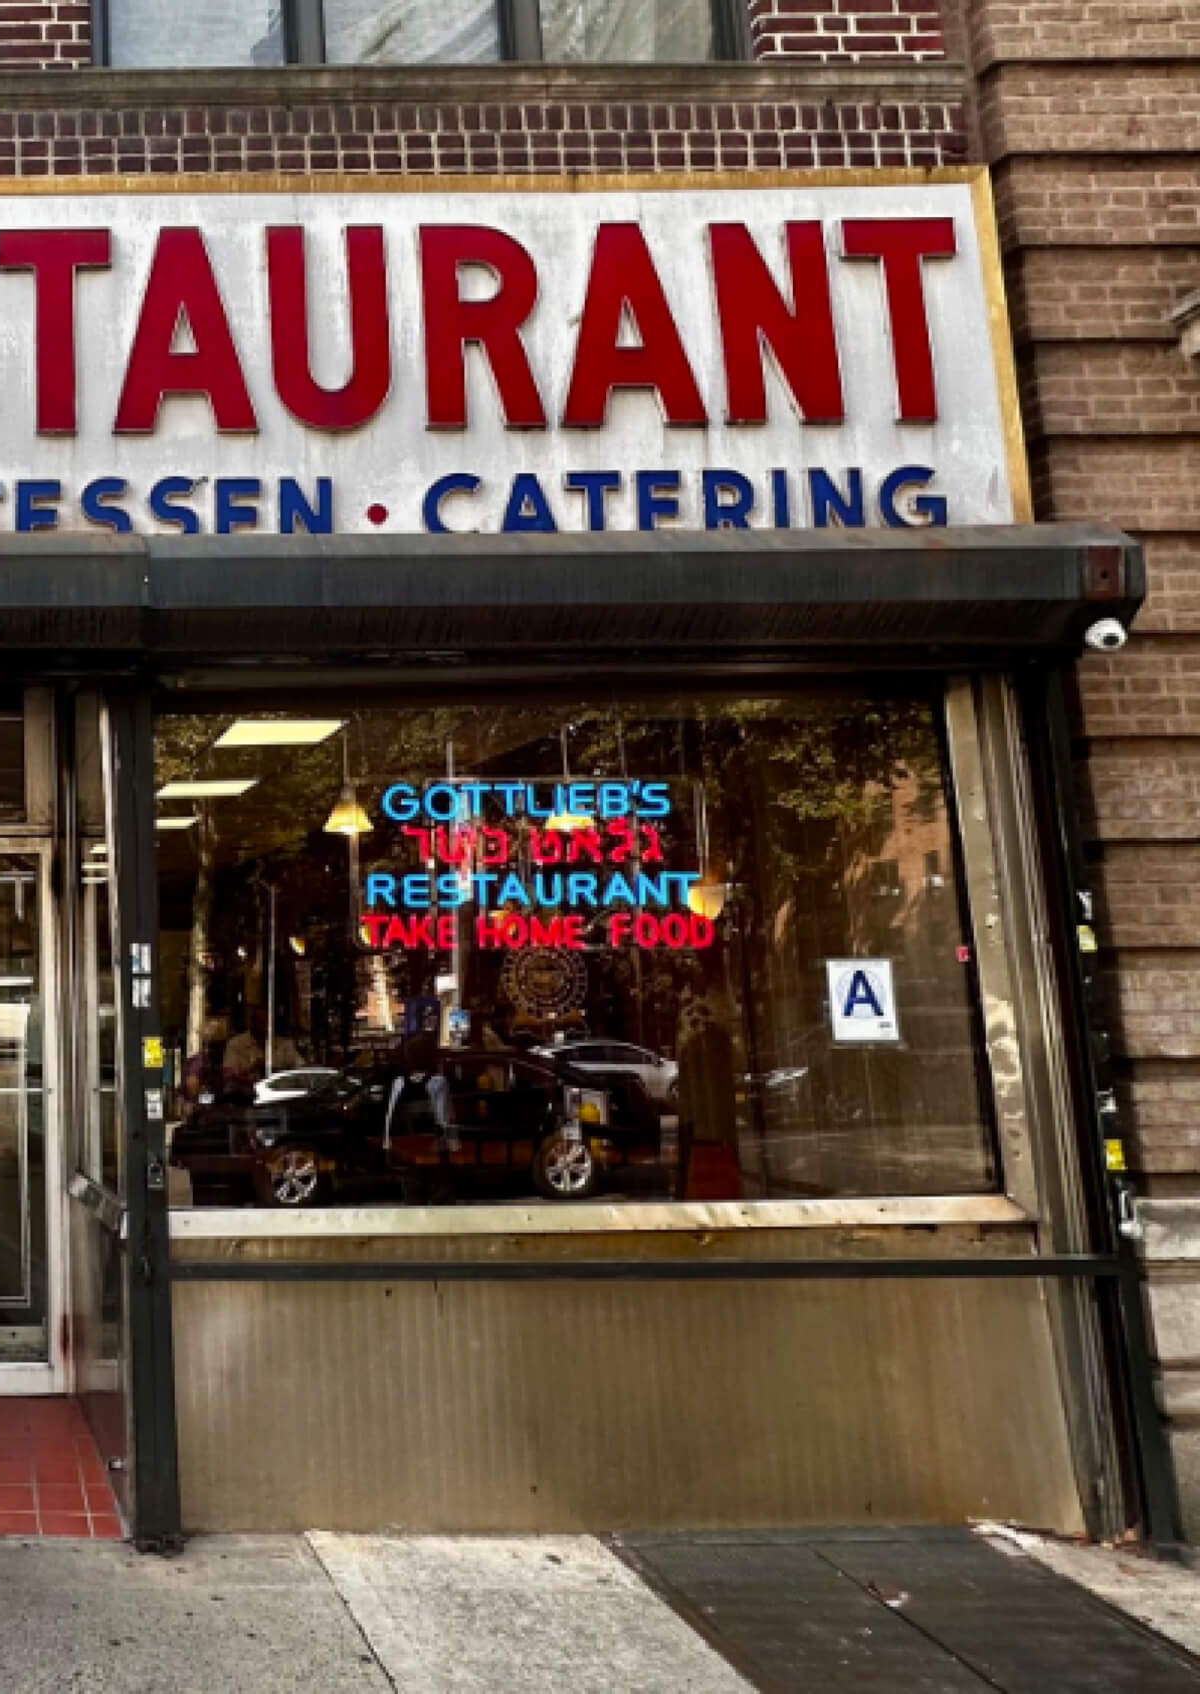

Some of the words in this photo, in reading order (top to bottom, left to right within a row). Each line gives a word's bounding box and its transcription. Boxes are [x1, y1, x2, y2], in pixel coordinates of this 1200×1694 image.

[421, 466, 948, 533] CATERING
[381, 779, 672, 821] GOTTLIEB'S
[366, 871, 702, 907] RESTAURANT
[360, 914, 457, 949] TAKE
[477, 913, 586, 949] HOME
[609, 912, 716, 949] FOOD
[843, 969, 885, 1017] A
